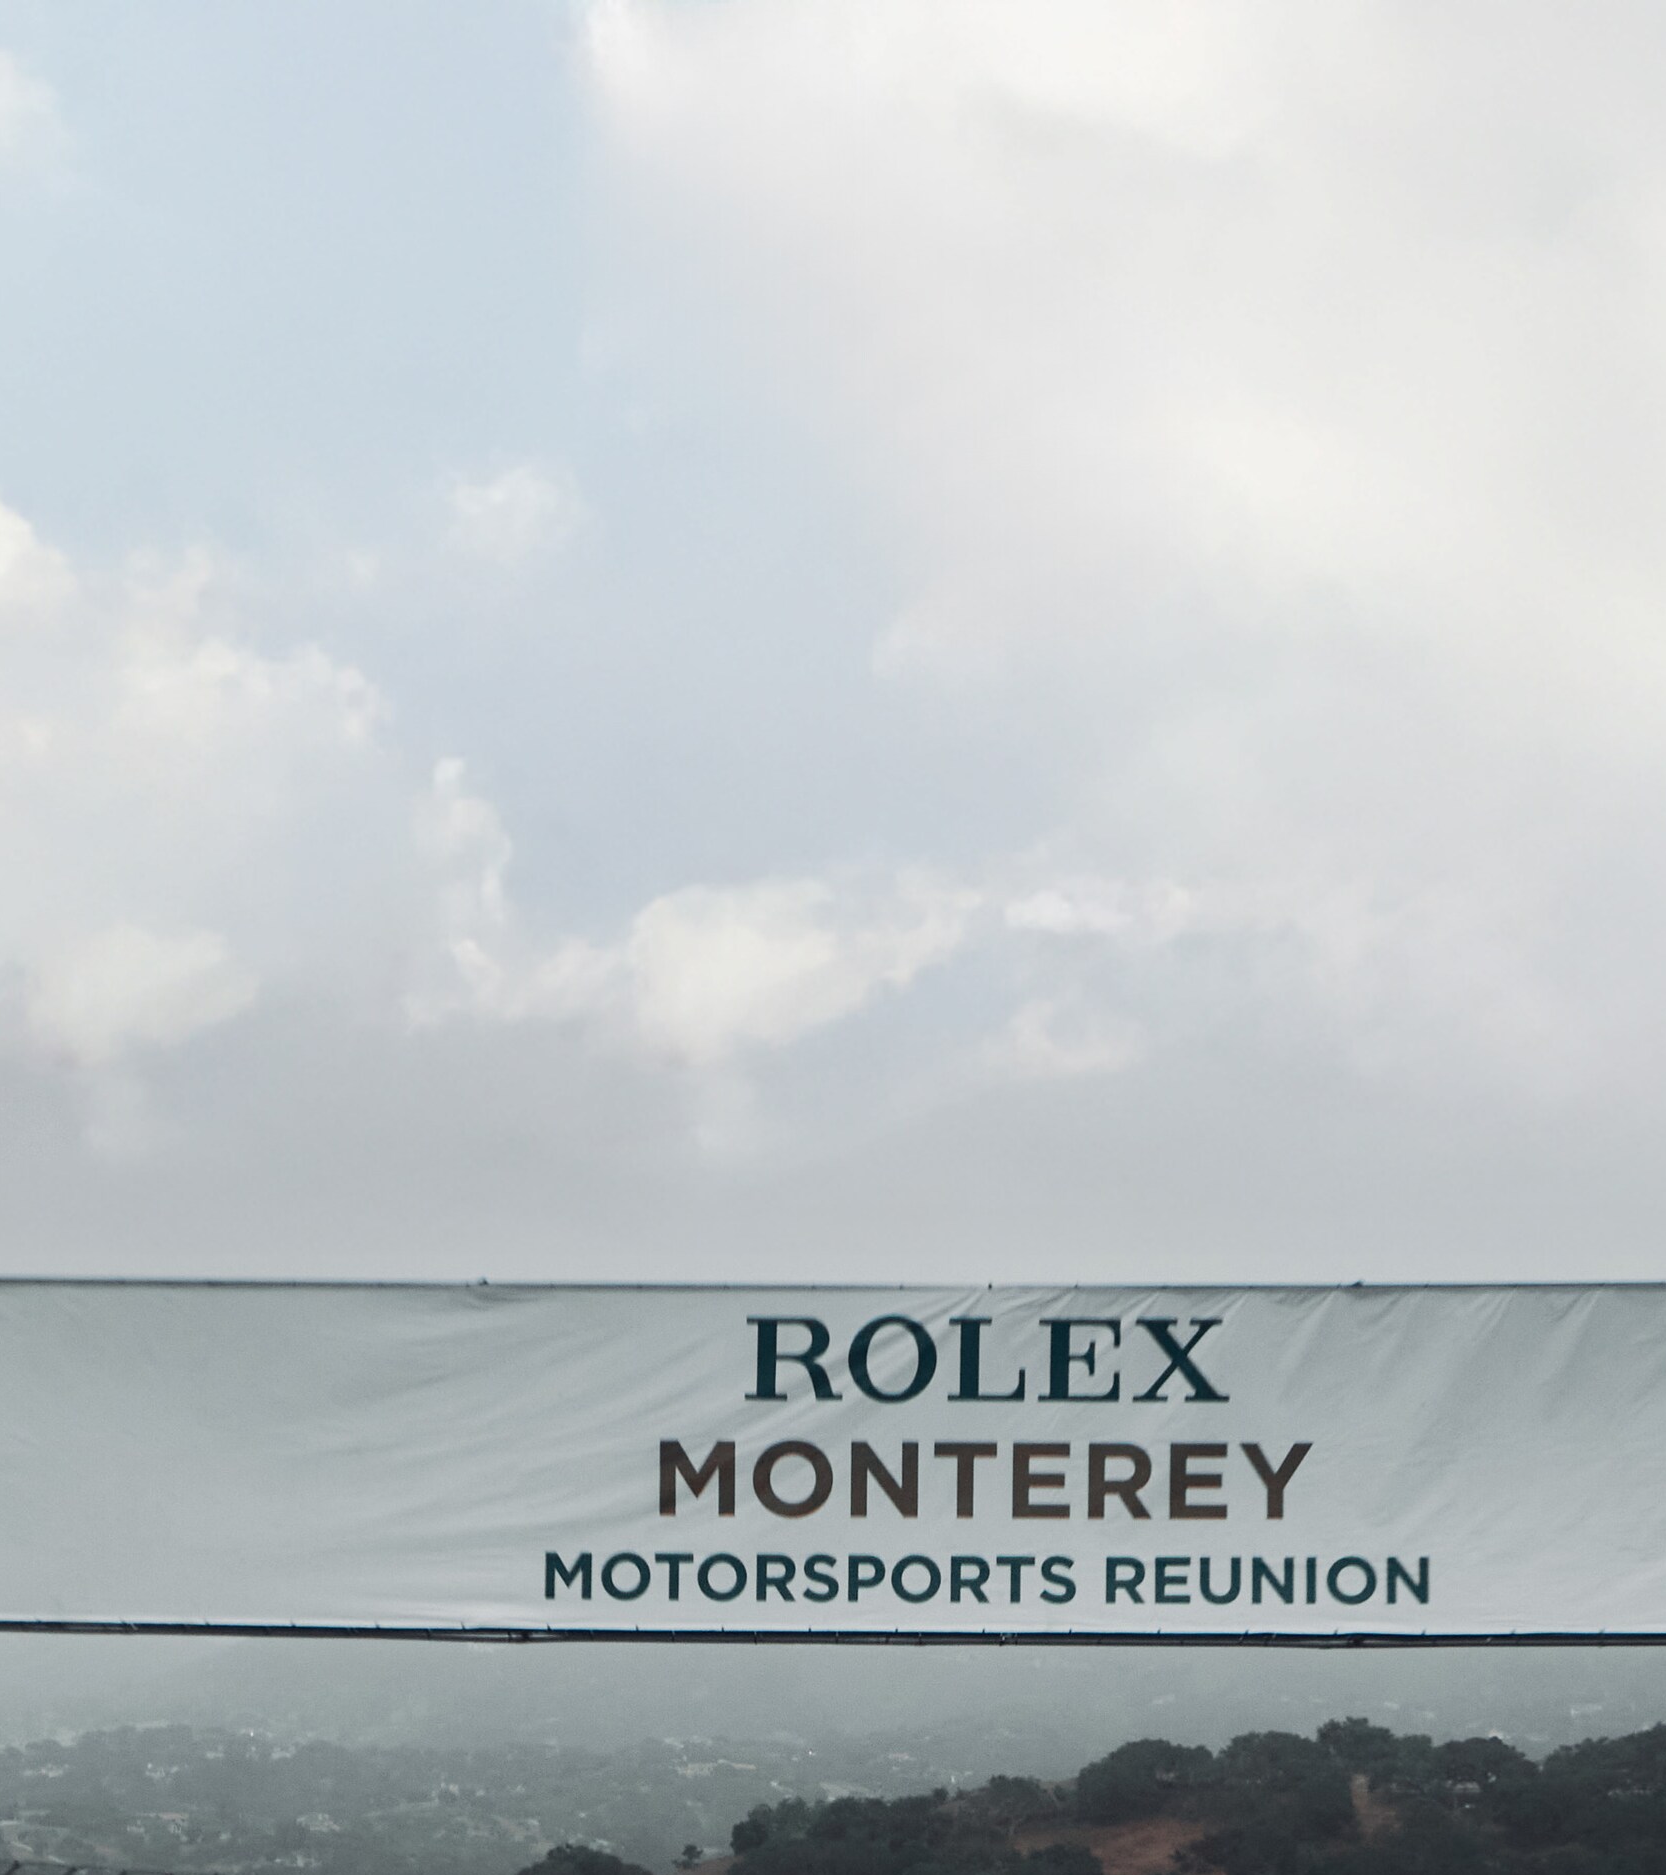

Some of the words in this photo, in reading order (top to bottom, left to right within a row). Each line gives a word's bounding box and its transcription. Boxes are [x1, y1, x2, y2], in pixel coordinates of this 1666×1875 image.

[744, 1315, 1230, 1404] ROLEX
[658, 1439, 1313, 1520] MONTEREY
[544, 1551, 1077, 1605] MOTORSPORTS
[1105, 1555, 1430, 1606] REUNION
